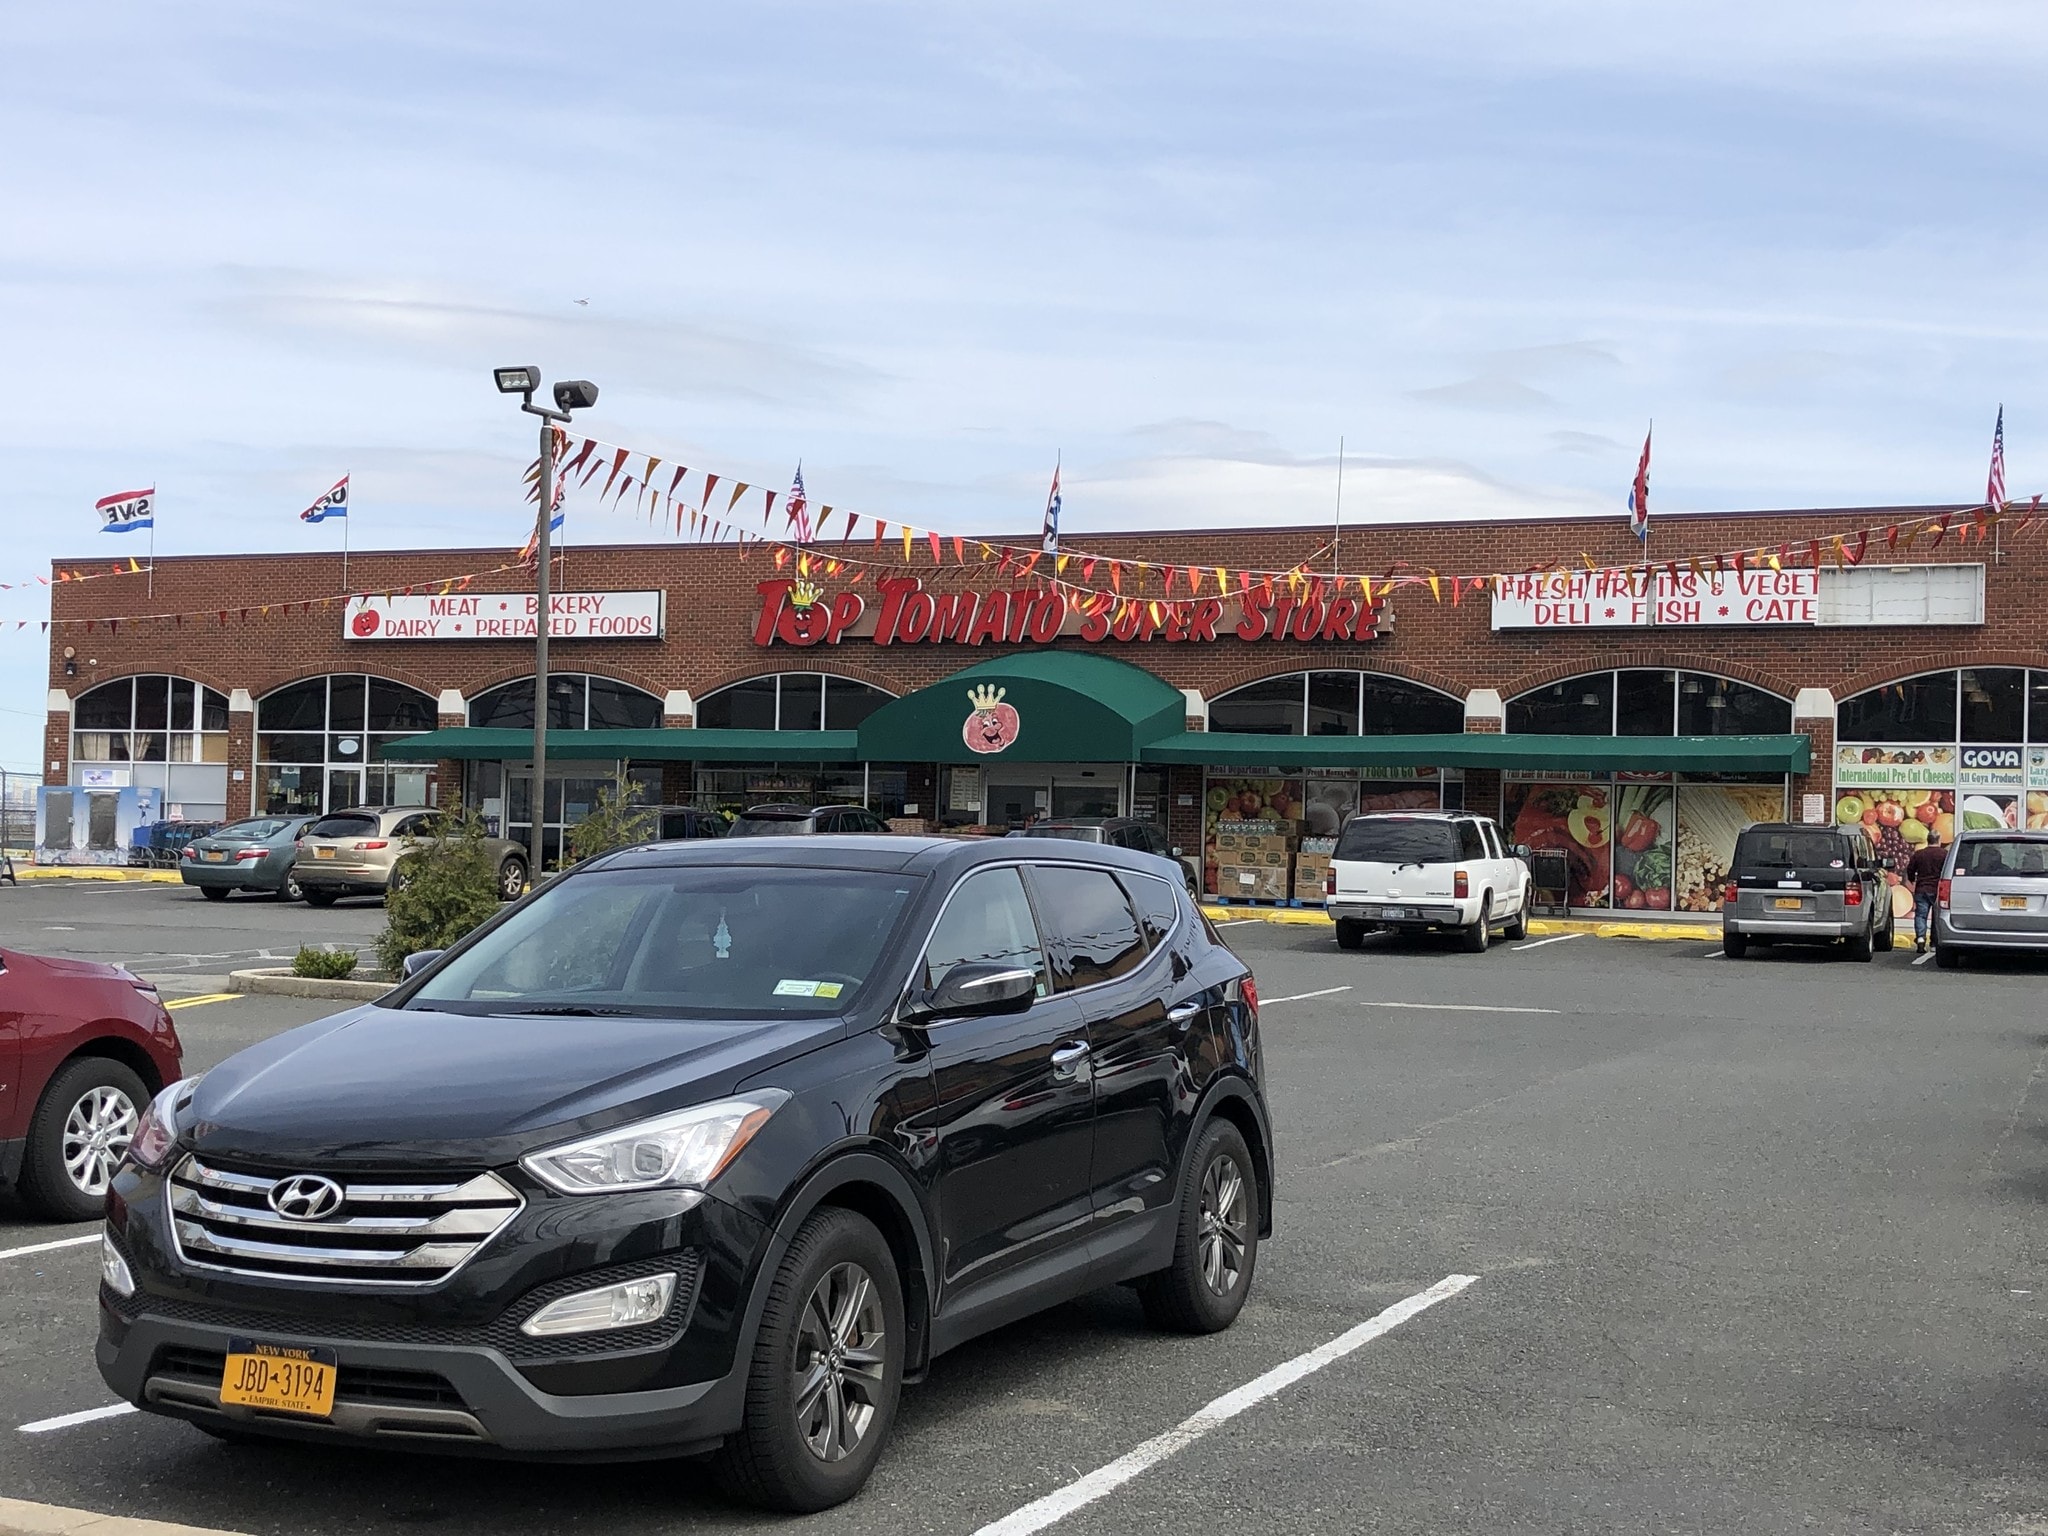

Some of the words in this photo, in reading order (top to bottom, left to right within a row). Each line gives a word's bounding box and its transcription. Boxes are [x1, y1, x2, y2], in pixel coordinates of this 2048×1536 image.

[1502, 578, 1584, 600] FRESH
[1711, 582, 1725, 596] &
[430, 598, 482, 616] MEAT
[525, 596, 605, 615] BKERY
[873, 577, 1067, 646] TOMATO
[1080, 590, 1223, 642] SUPER
[1237, 583, 1386, 642] STORE
[1535, 603, 1590, 625] DELI
[1632, 600, 1701, 623] FISH
[1746, 599, 1817, 622] CATE
[385, 619, 441, 637] DAIRY
[476, 617, 577, 636] PREPAED
[588, 615, 653, 635] FOODS
[1963, 750, 2019, 767] GOYA
[1838, 768, 1890, 783] International
[1892, 768, 1906, 783] Pre
[1908, 768, 1921, 783] Cut
[1923, 768, 1955, 783] Cheeses
[1960, 772, 1970, 783] All
[1971, 772, 1989, 785] Goya
[1991, 772, 2023, 784] Products
[255, 1344, 281, 1357] NEW
[283, 1347, 311, 1360] YORK
[249, 1395, 280, 1406] EMPIRE
[281, 1400, 306, 1410] STATE
